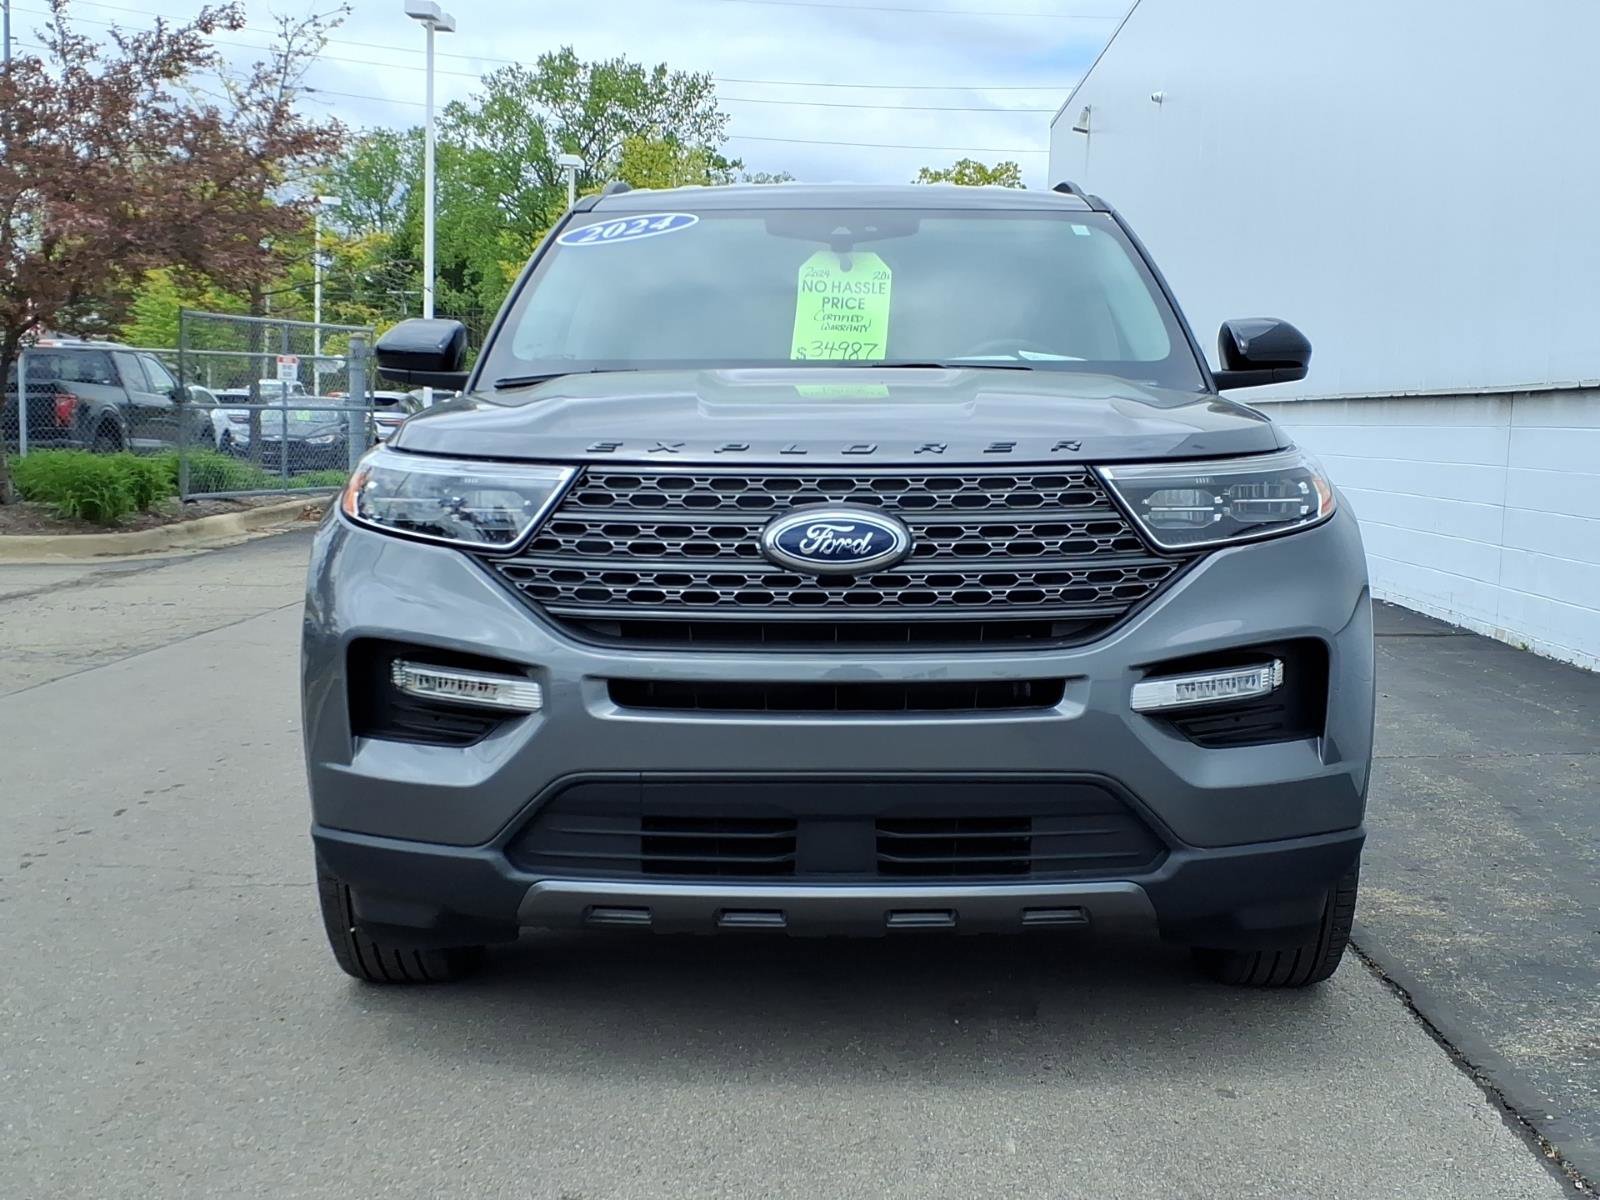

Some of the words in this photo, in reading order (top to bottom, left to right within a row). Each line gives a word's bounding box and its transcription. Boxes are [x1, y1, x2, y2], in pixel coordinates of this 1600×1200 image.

[577, 215, 676, 242] 2024
[802, 279, 828, 293] NO
[831, 281, 887, 295] HASSLE
[822, 296, 866, 310] PRICE
[585, 440, 1083, 456] EXPLORER
[799, 523, 874, 555] Ford
